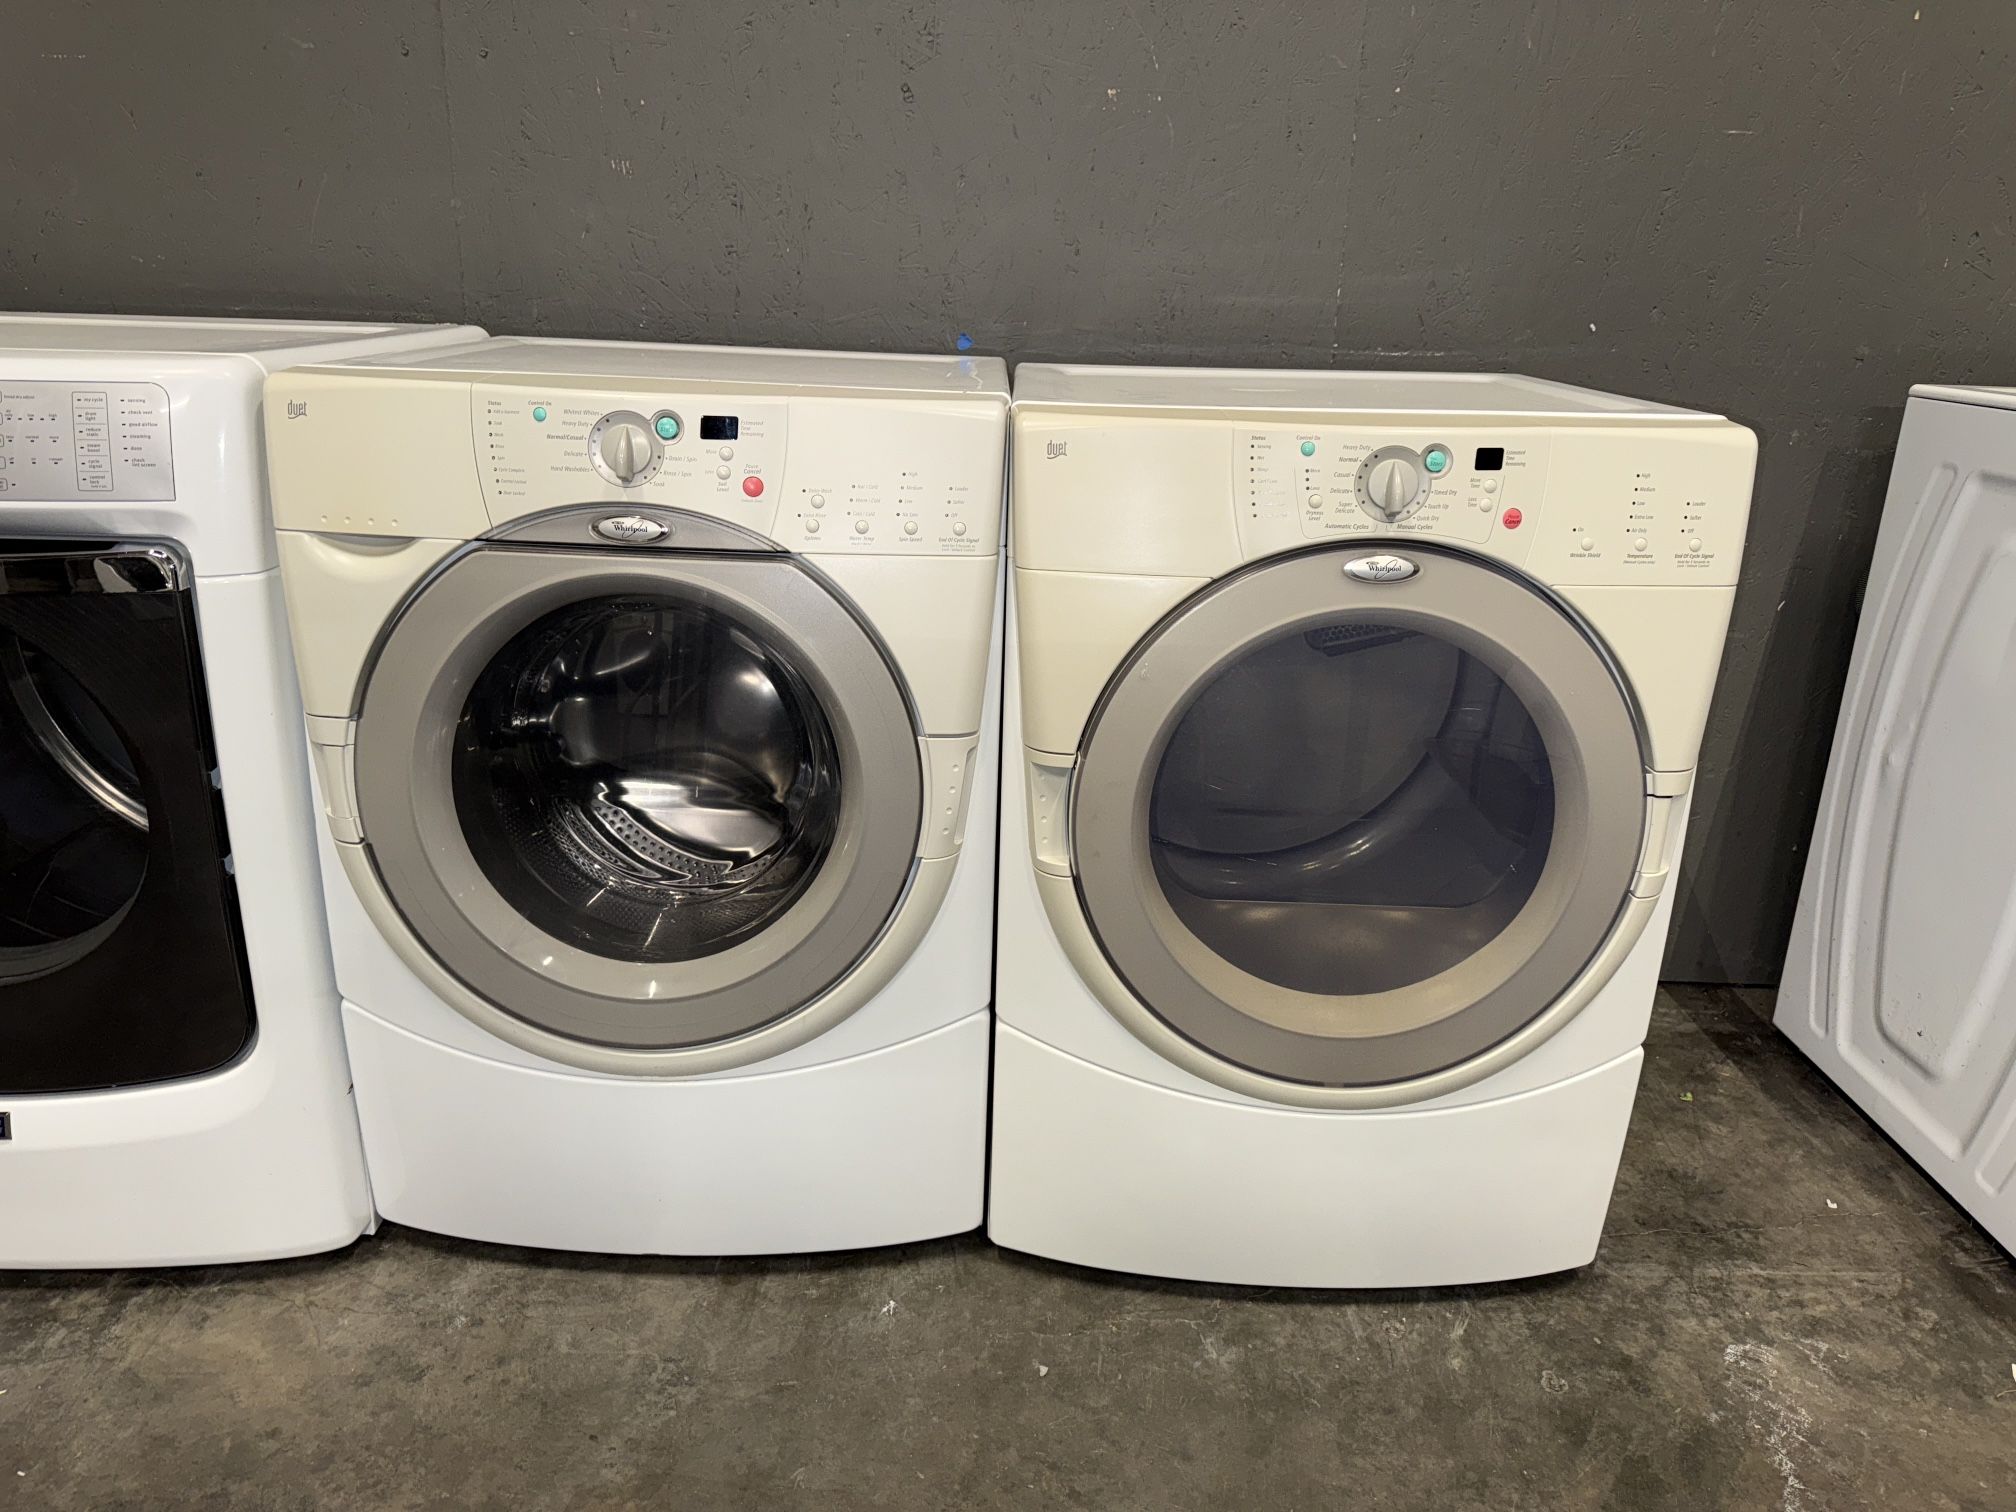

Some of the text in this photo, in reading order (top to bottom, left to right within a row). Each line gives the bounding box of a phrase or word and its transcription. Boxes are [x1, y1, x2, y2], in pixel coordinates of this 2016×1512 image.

[288, 399, 307, 419] duet
[1046, 440, 1068, 460] duet
[613, 525, 648, 533] Whirlpool
[1368, 564, 1401, 573] Whirlpool
